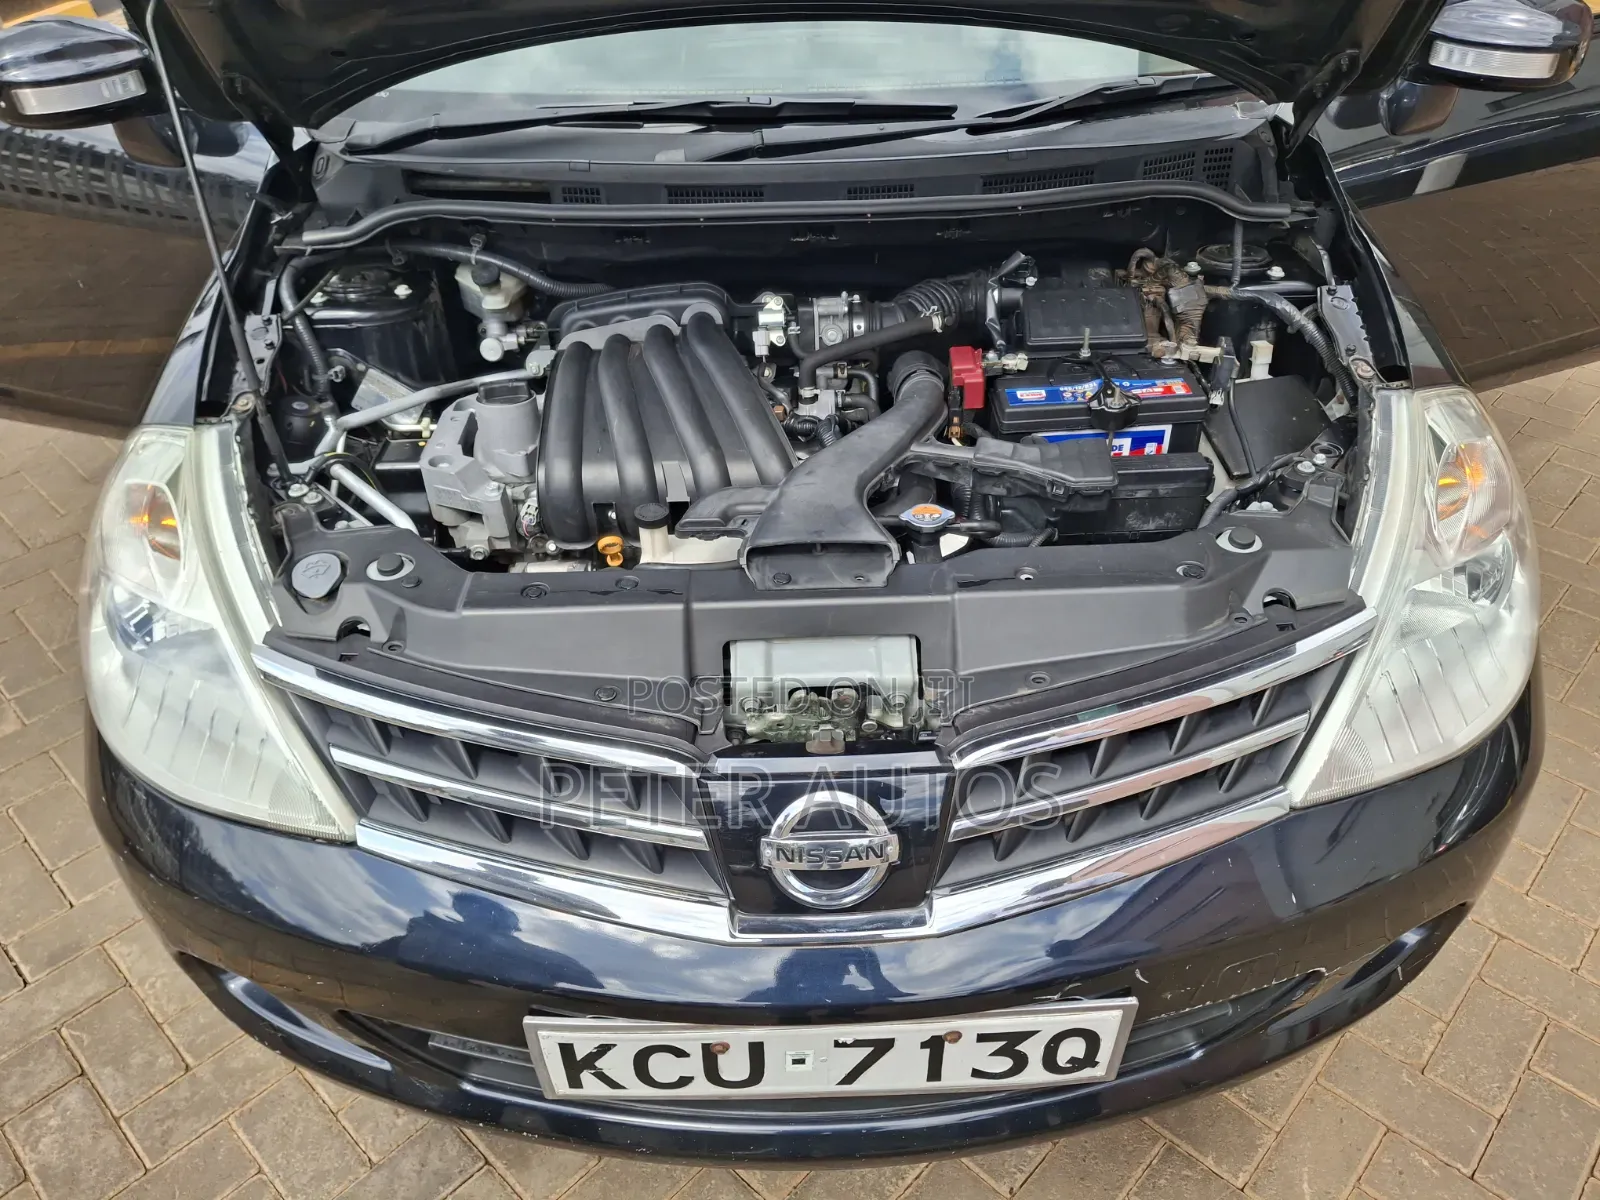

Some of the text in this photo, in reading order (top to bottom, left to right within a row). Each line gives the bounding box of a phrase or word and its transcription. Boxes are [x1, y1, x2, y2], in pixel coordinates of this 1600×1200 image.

[775, 842, 887, 864] NISSAN
[557, 1027, 1103, 1091] KCU 713Q
